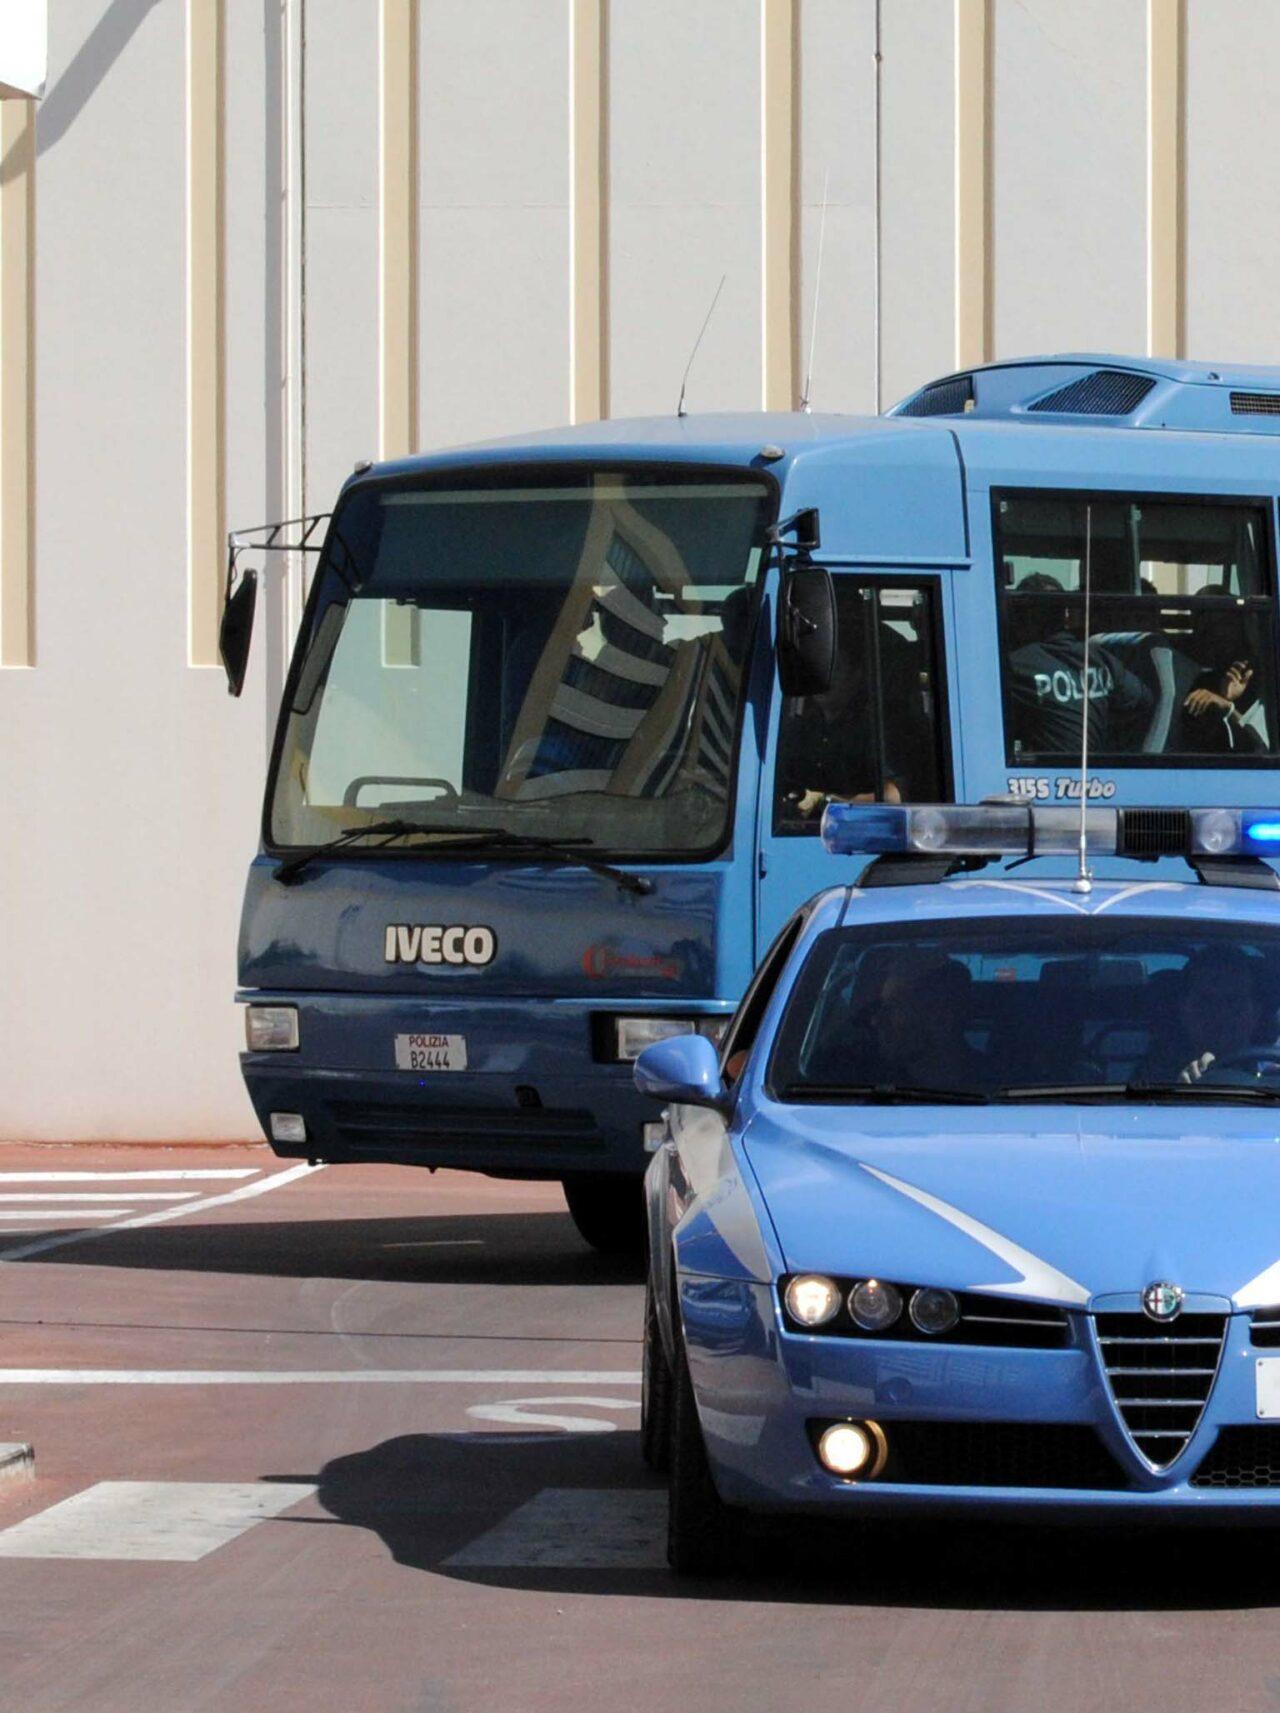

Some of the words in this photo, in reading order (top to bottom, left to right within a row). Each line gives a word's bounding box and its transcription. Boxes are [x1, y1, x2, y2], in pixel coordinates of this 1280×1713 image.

[384, 925, 496, 965] IVECO
[408, 1035, 449, 1048] POLIZIA
[410, 1050, 450, 1069] B2444
